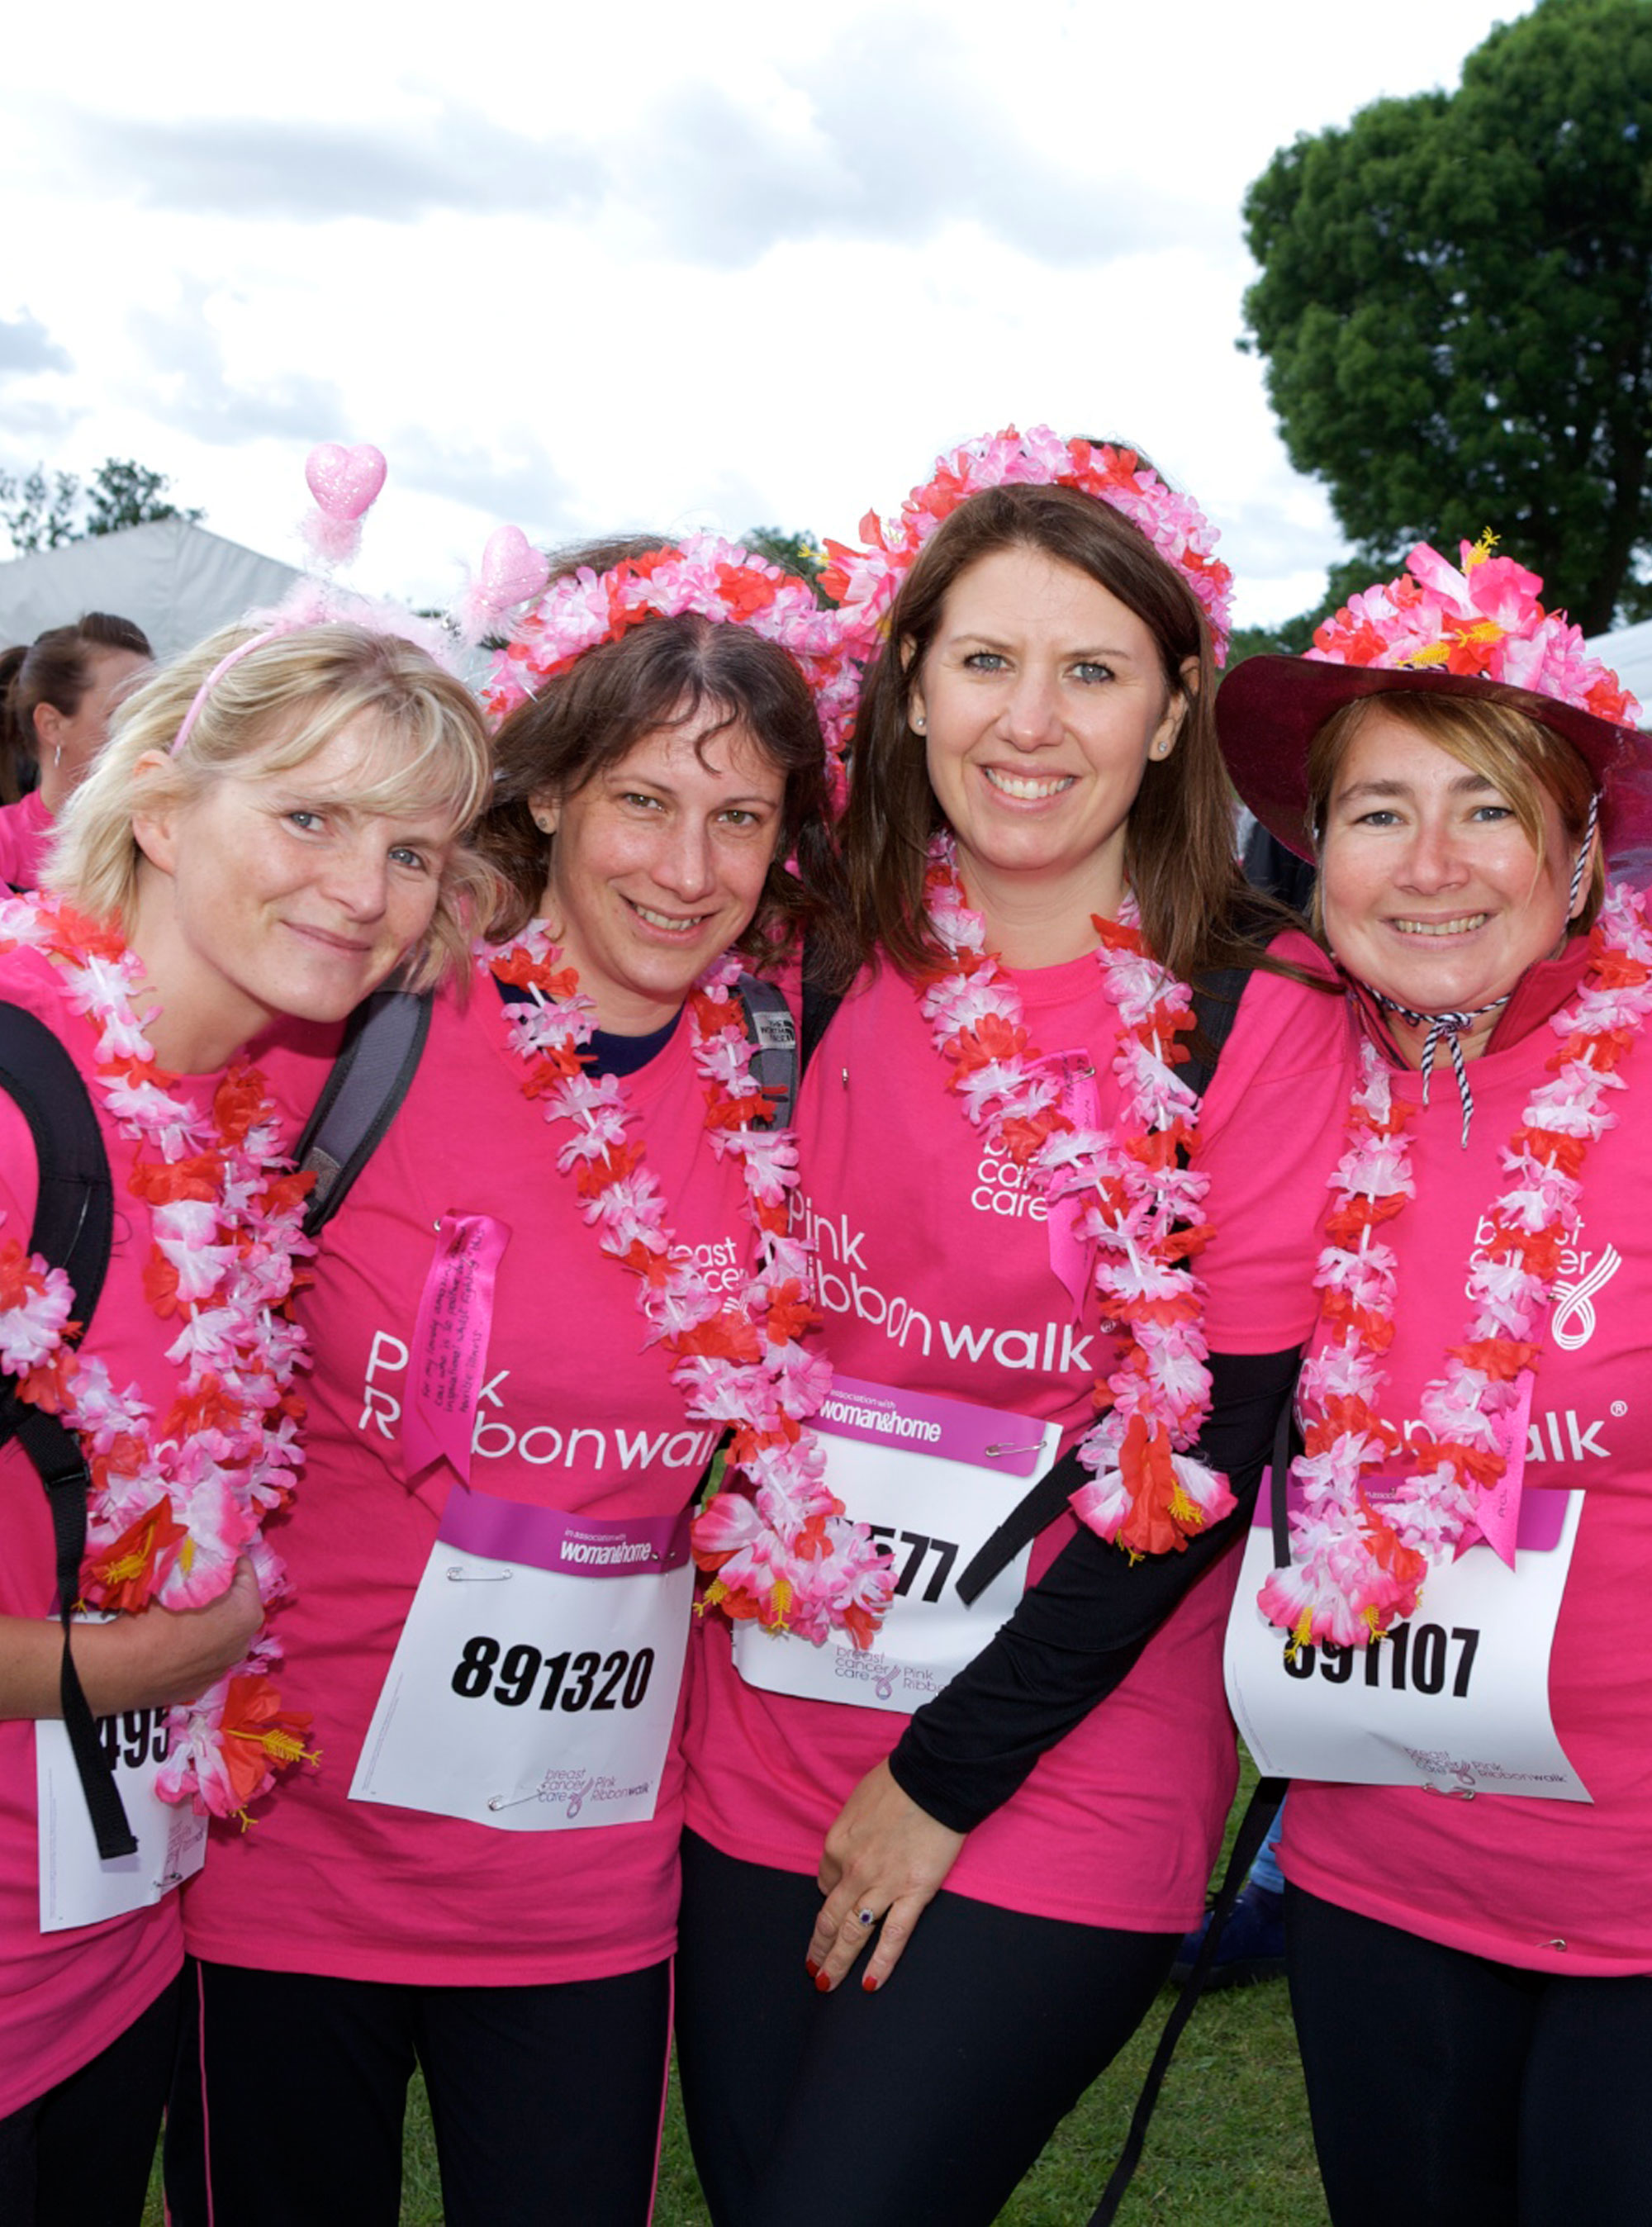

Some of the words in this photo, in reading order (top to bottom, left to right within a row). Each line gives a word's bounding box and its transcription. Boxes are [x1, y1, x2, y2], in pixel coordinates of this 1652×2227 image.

[971, 1185, 1047, 1222] care
[364, 1329, 511, 1408] Pk
[819, 1400, 942, 1443] woman&home
[559, 1541, 652, 1565] woman&home
[451, 1636, 655, 1713] 891320
[835, 1656, 890, 1675] cancer
[835, 1667, 870, 1682] care
[904, 1666, 933, 1680] Pink
[544, 1768, 586, 1782] breast
[595, 1776, 616, 1788] Pink
[540, 1779, 586, 1793] cancer
[590, 1782, 649, 1802] Ribbonwalk
[538, 1790, 567, 1803] care
